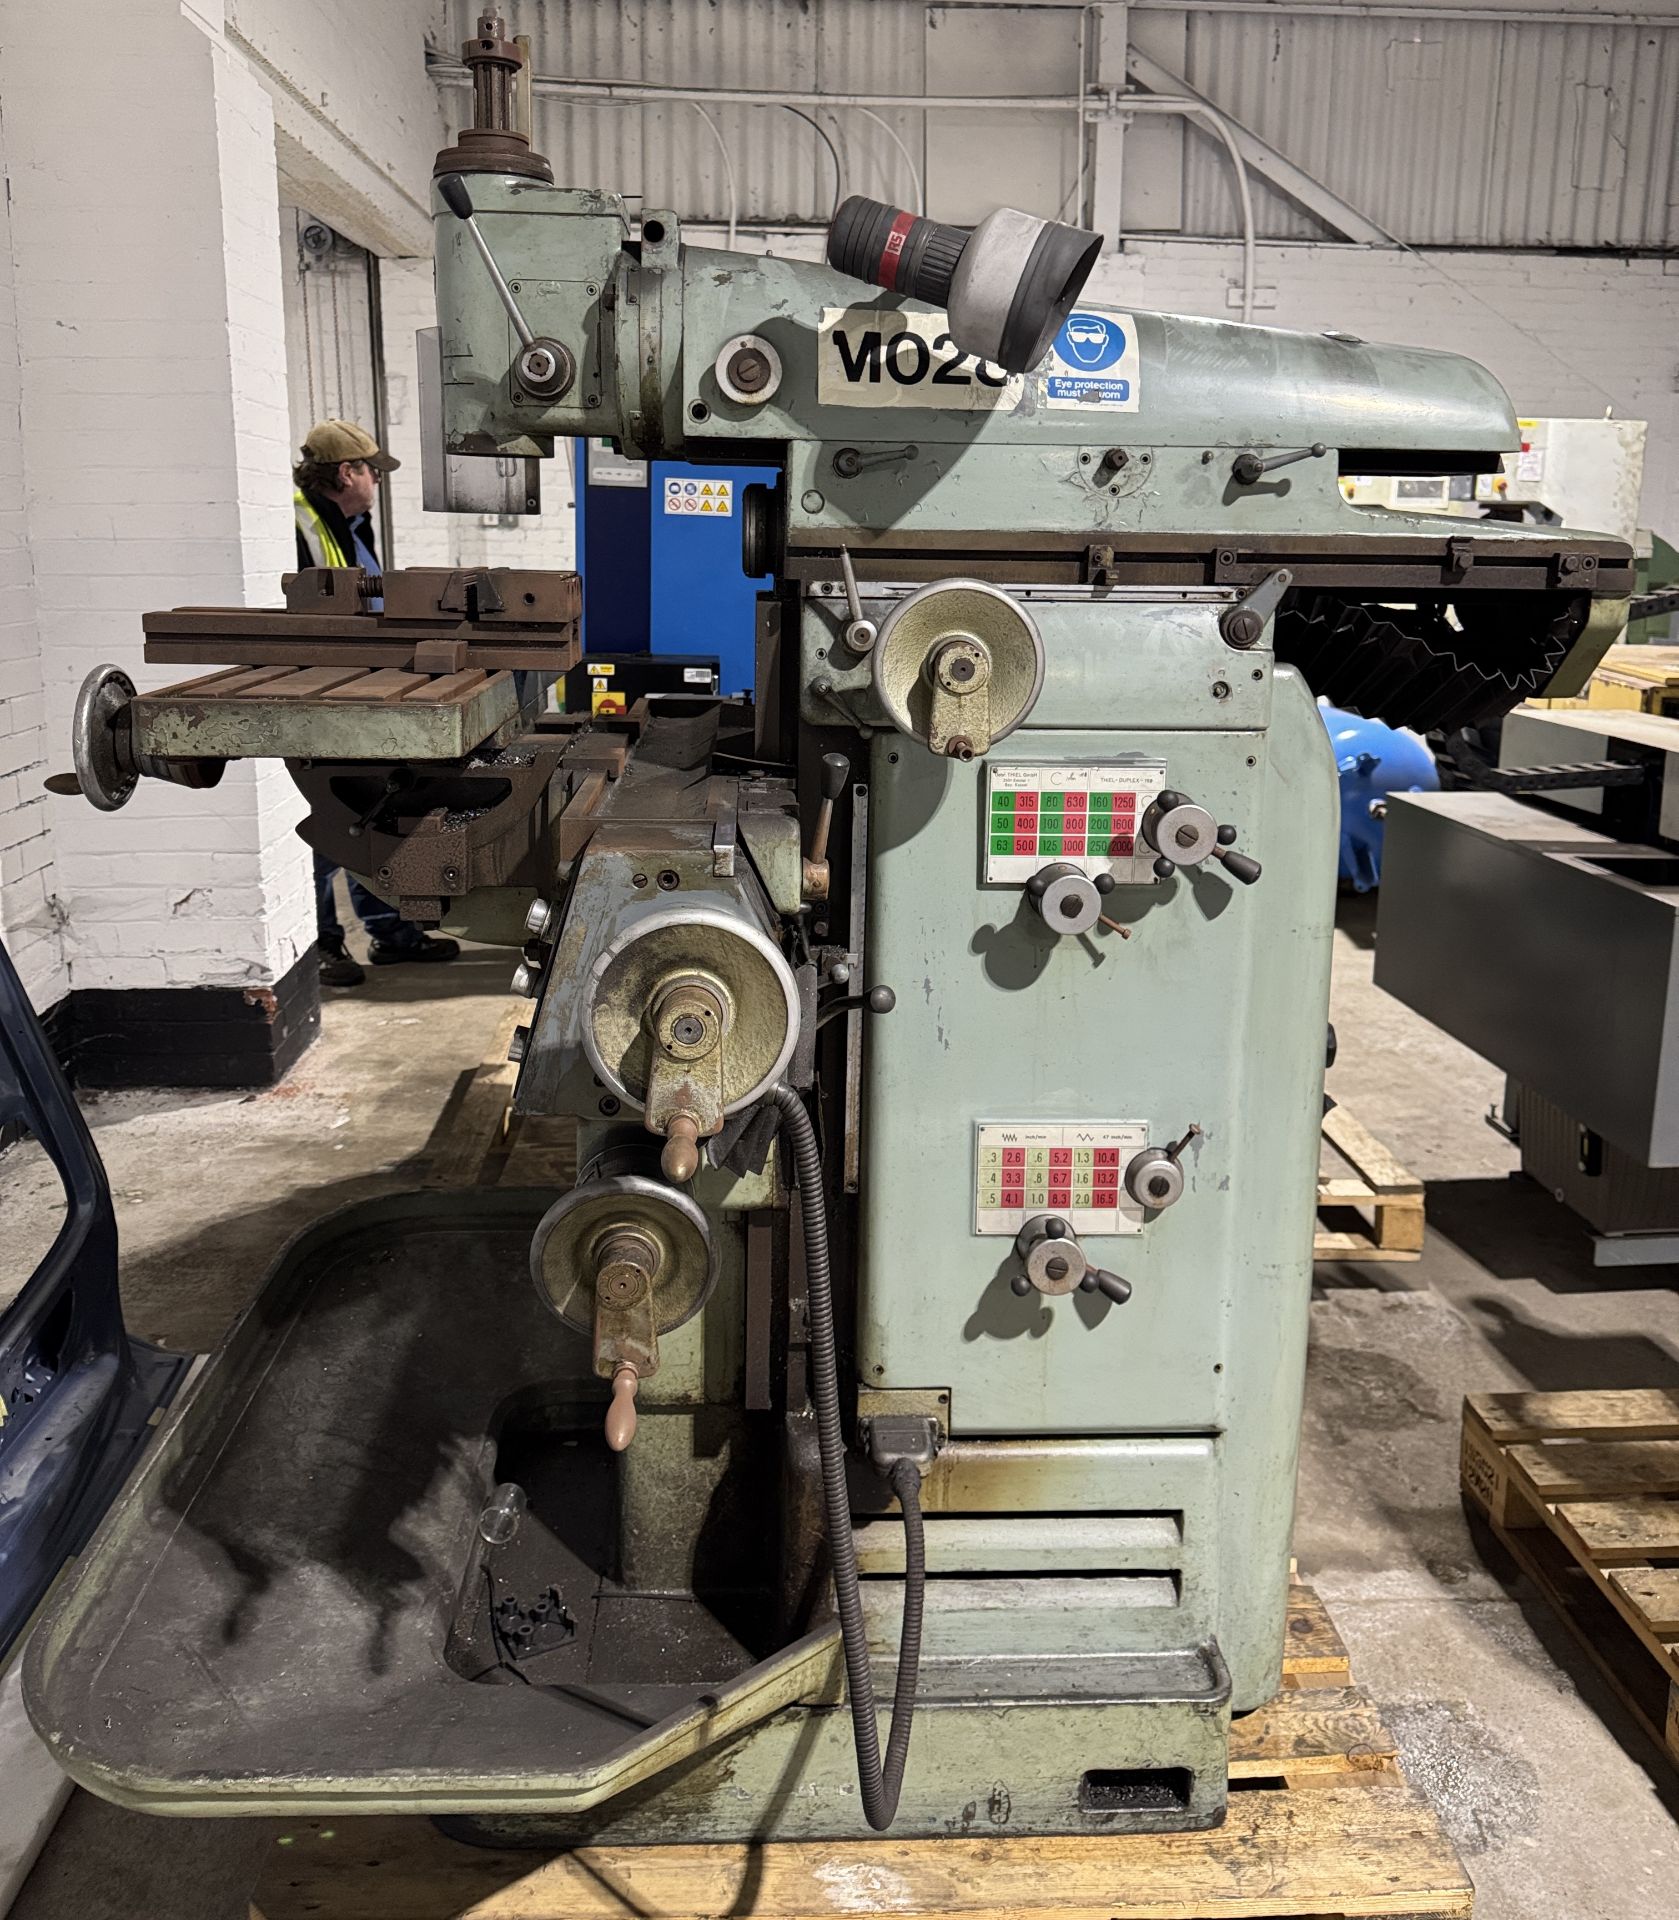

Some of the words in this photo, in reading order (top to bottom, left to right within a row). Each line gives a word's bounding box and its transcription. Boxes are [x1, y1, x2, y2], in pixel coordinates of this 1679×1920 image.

[1055, 379, 1073, 390] Eye
[1075, 381, 1124, 391] protection
[1057, 389, 1080, 397] must
[997, 796, 1010, 807] 40
[1019, 796, 1034, 807] 315
[1066, 796, 1084, 807] 630
[1093, 797, 1108, 808] 160
[1114, 797, 1134, 808] 1250
[996, 818, 1009, 829] 50
[1017, 818, 1035, 829] 400
[1043, 818, 1059, 829] 100
[1065, 818, 1084, 829] 800
[1091, 819, 1109, 830] 200
[1113, 819, 1133, 830] 1600
[996, 840, 1008, 851] 63
[1016, 840, 1034, 851] 500
[1043, 840, 1057, 851] 125
[1064, 840, 1084, 851] 1000
[1090, 841, 1108, 852] 250
[1112, 841, 1133, 852] 2000
[987, 1152, 997, 1163] .3
[1007, 1152, 1021, 1163] 2.6
[1034, 1152, 1043, 1163] .6
[1054, 1152, 1068, 1163] 5.2
[1077, 1152, 1090, 1163] 1.3
[1098, 1152, 1116, 1163] 10.4
[986, 1173, 996, 1183] .4
[1006, 1173, 1021, 1183] 3.3
[1034, 1173, 1042, 1183] .8
[1053, 1173, 1067, 1183] 6.7
[1076, 1173, 1089, 1183] 1.6
[1097, 1173, 1115, 1183] 13.2
[986, 1193, 996, 1204] .5
[1005, 1193, 1018, 1204] 4.1
[1031, 1193, 1044, 1204] 1.0
[1052, 1193, 1067, 1204] 8.3
[1075, 1193, 1090, 1204] 2.0
[1096, 1193, 1114, 1204] 16.5
